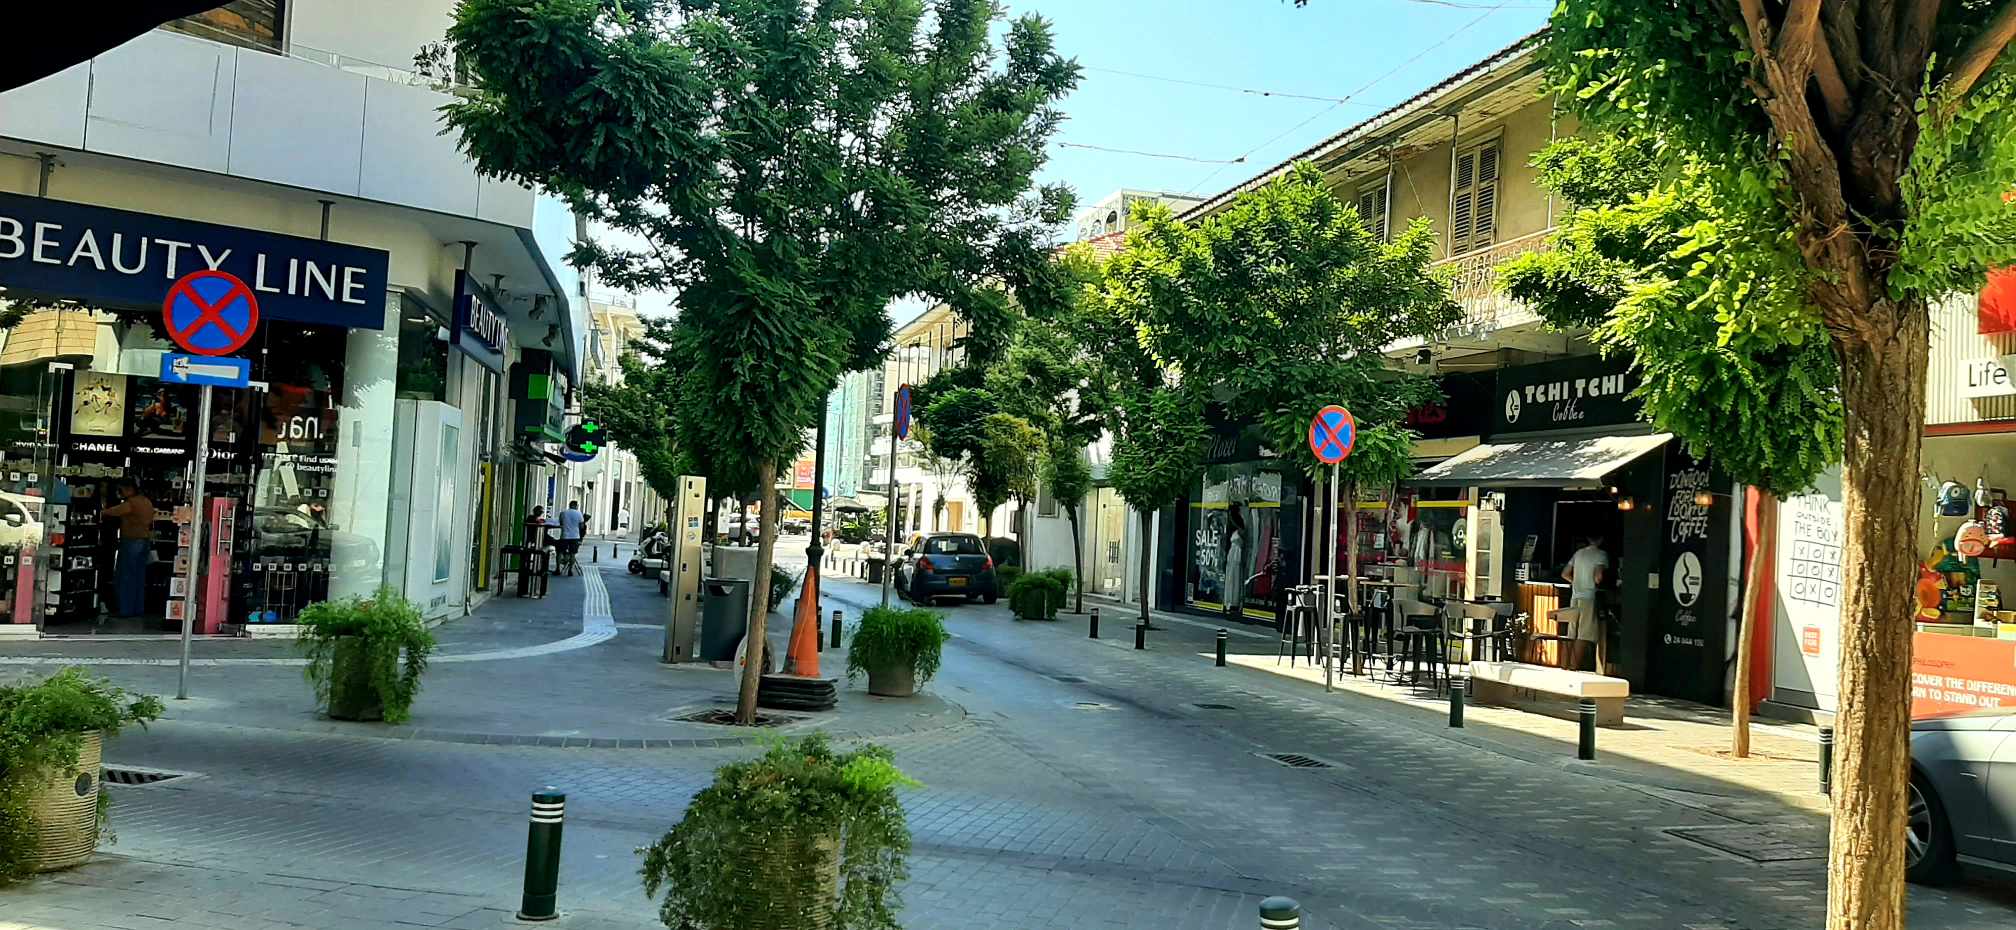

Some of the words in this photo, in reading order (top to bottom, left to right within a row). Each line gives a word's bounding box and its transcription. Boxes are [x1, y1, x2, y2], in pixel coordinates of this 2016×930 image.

[0, 217, 232, 280] BEAUTY
[255, 253, 367, 305] LINE
[470, 294, 497, 345] BEAUTY
[1968, 361, 2007, 387] Life
[1525, 381, 1569, 403] TCHI
[1576, 373, 1624, 399] TCHI
[72, 442, 120, 452] CHANEL
[207, 448, 238, 460] Dior
[1794, 520, 1811, 537] THE
[1195, 529, 1219, 547] SALE
[1911, 672, 1943, 687] COVER
[1944, 677, 1965, 690] THE
[1928, 688, 1942, 701] TO
